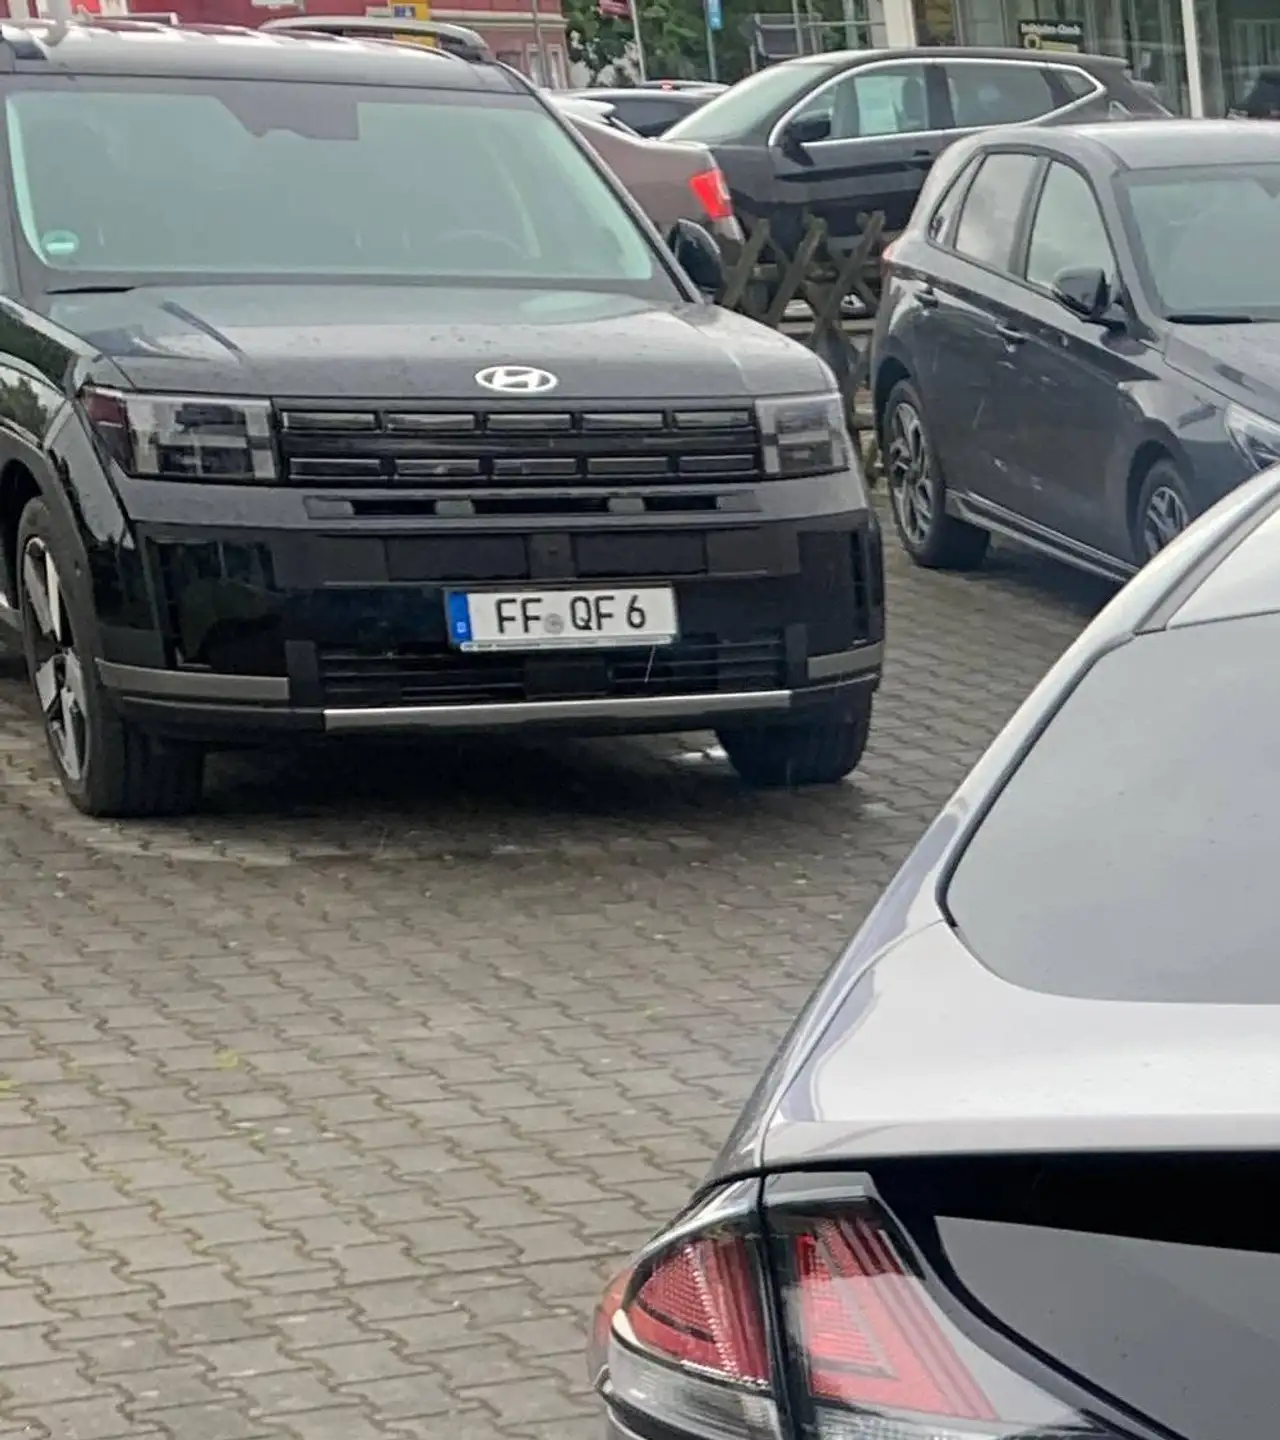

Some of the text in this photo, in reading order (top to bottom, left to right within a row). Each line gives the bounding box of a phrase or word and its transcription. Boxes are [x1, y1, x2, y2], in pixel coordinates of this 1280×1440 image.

[495, 597, 542, 634] FF
[570, 595, 615, 632] QF
[626, 594, 647, 630] 6
